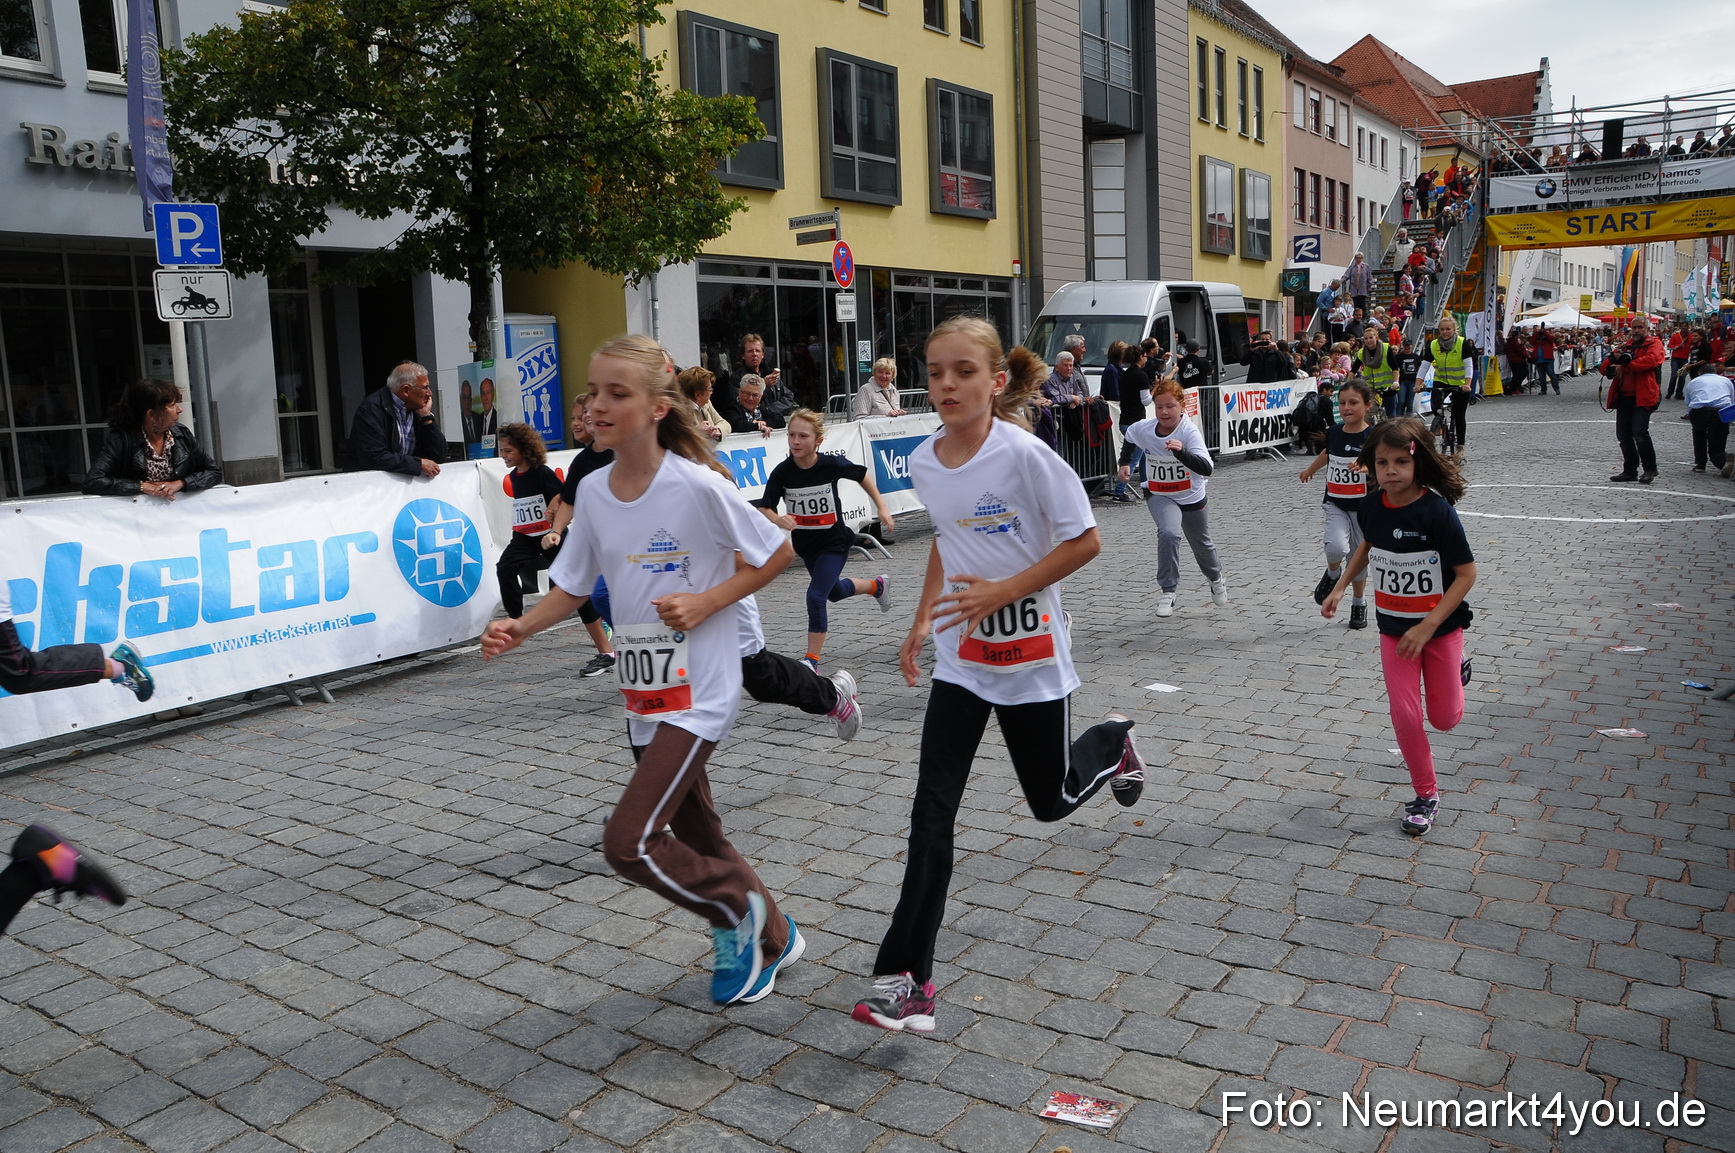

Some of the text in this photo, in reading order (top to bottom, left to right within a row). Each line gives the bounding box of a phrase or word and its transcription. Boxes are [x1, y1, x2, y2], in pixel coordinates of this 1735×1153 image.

[1562, 168, 1702, 187] BMW EfficientDynamics
[1562, 187, 1592, 196] Weniger
[1593, 184, 1633, 193] Verbrauch.
[790, 214, 834, 228] Brunnwirtsgasse
[1566, 210, 1658, 236] START
[169, 211, 204, 257] P
[1295, 237, 1319, 260] R.
[181, 274, 203, 285] nur
[1289, 276, 1299, 287] G2
[1721, 262, 1729, 298] HOTE
[1237, 387, 1291, 413] INTERSPORT
[1228, 413, 1295, 448] HACKNER
[880, 449, 911, 479] Neu
[1151, 465, 1186, 480] 7015
[1330, 467, 1360, 483] 7336
[788, 497, 829, 515] 7198
[1389, 559, 1426, 567] Neumarkt
[1375, 567, 1433, 595] 7326
[210, 613, 353, 655] www.slackstar.net
[625, 634, 669, 645] Neumarkt
[982, 645, 1023, 662] Sarah
